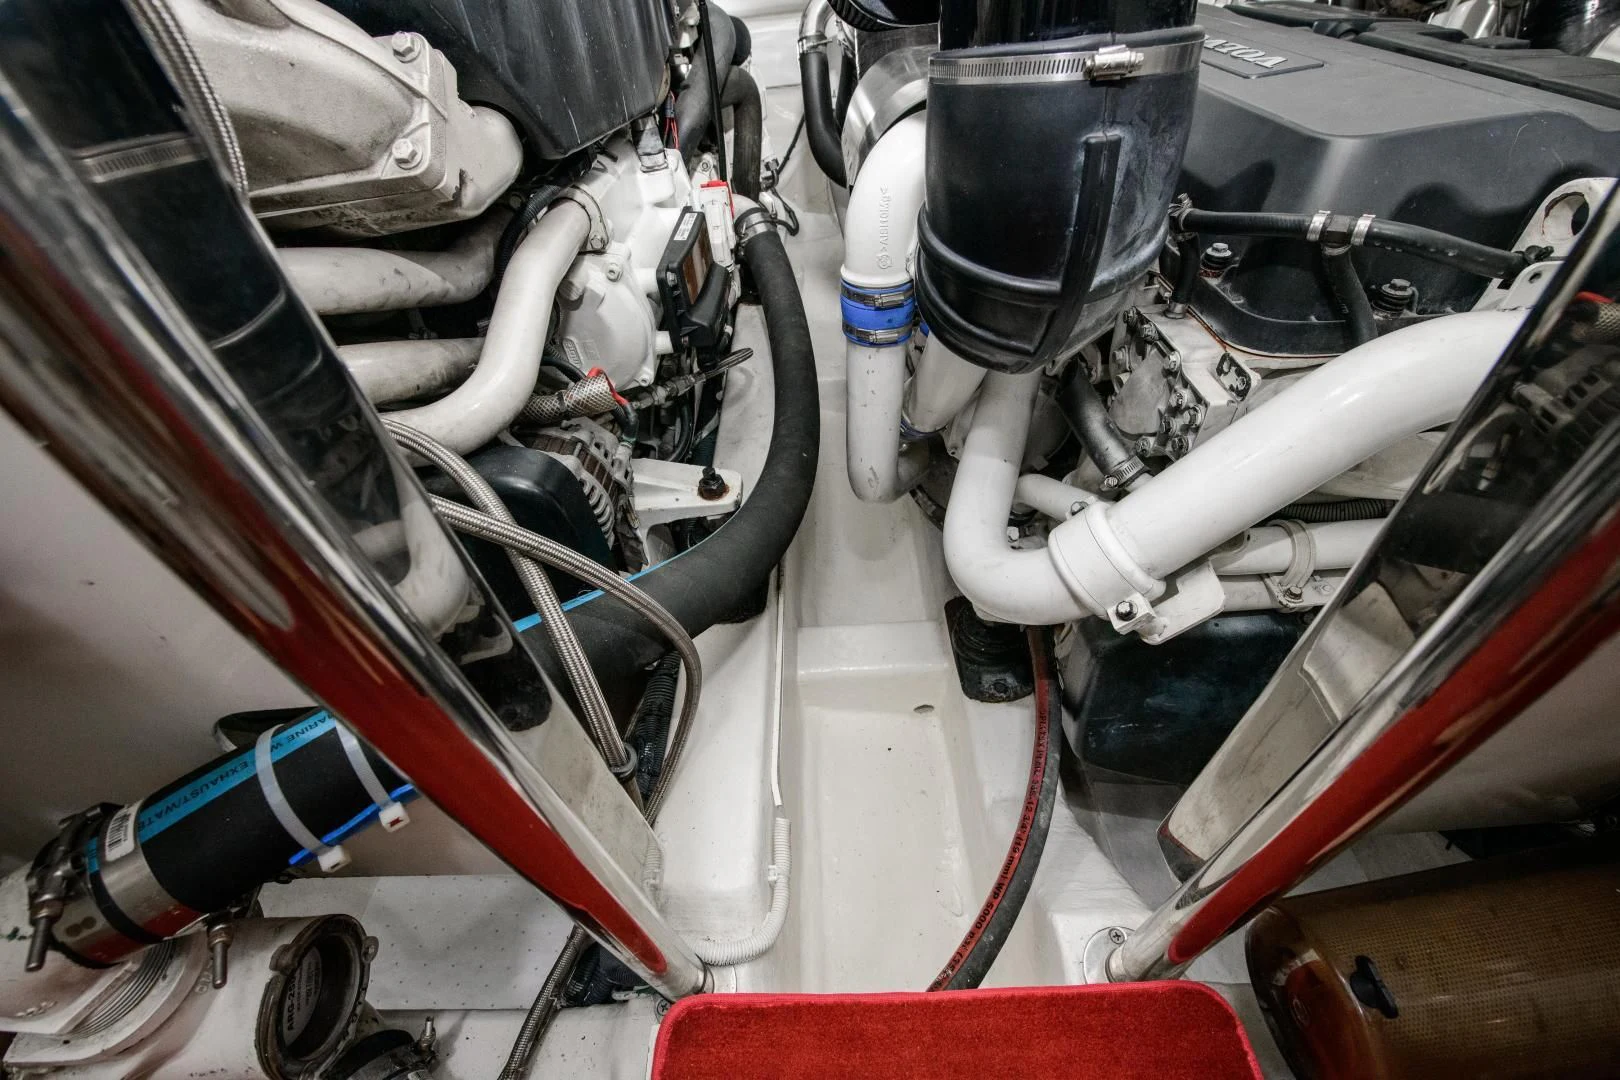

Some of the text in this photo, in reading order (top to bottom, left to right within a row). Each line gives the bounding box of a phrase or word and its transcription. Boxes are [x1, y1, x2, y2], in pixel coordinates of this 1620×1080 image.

[1203, 35, 1288, 68] VOLV
[992, 882, 1005, 900] WP
[975, 901, 995, 930] 5000
